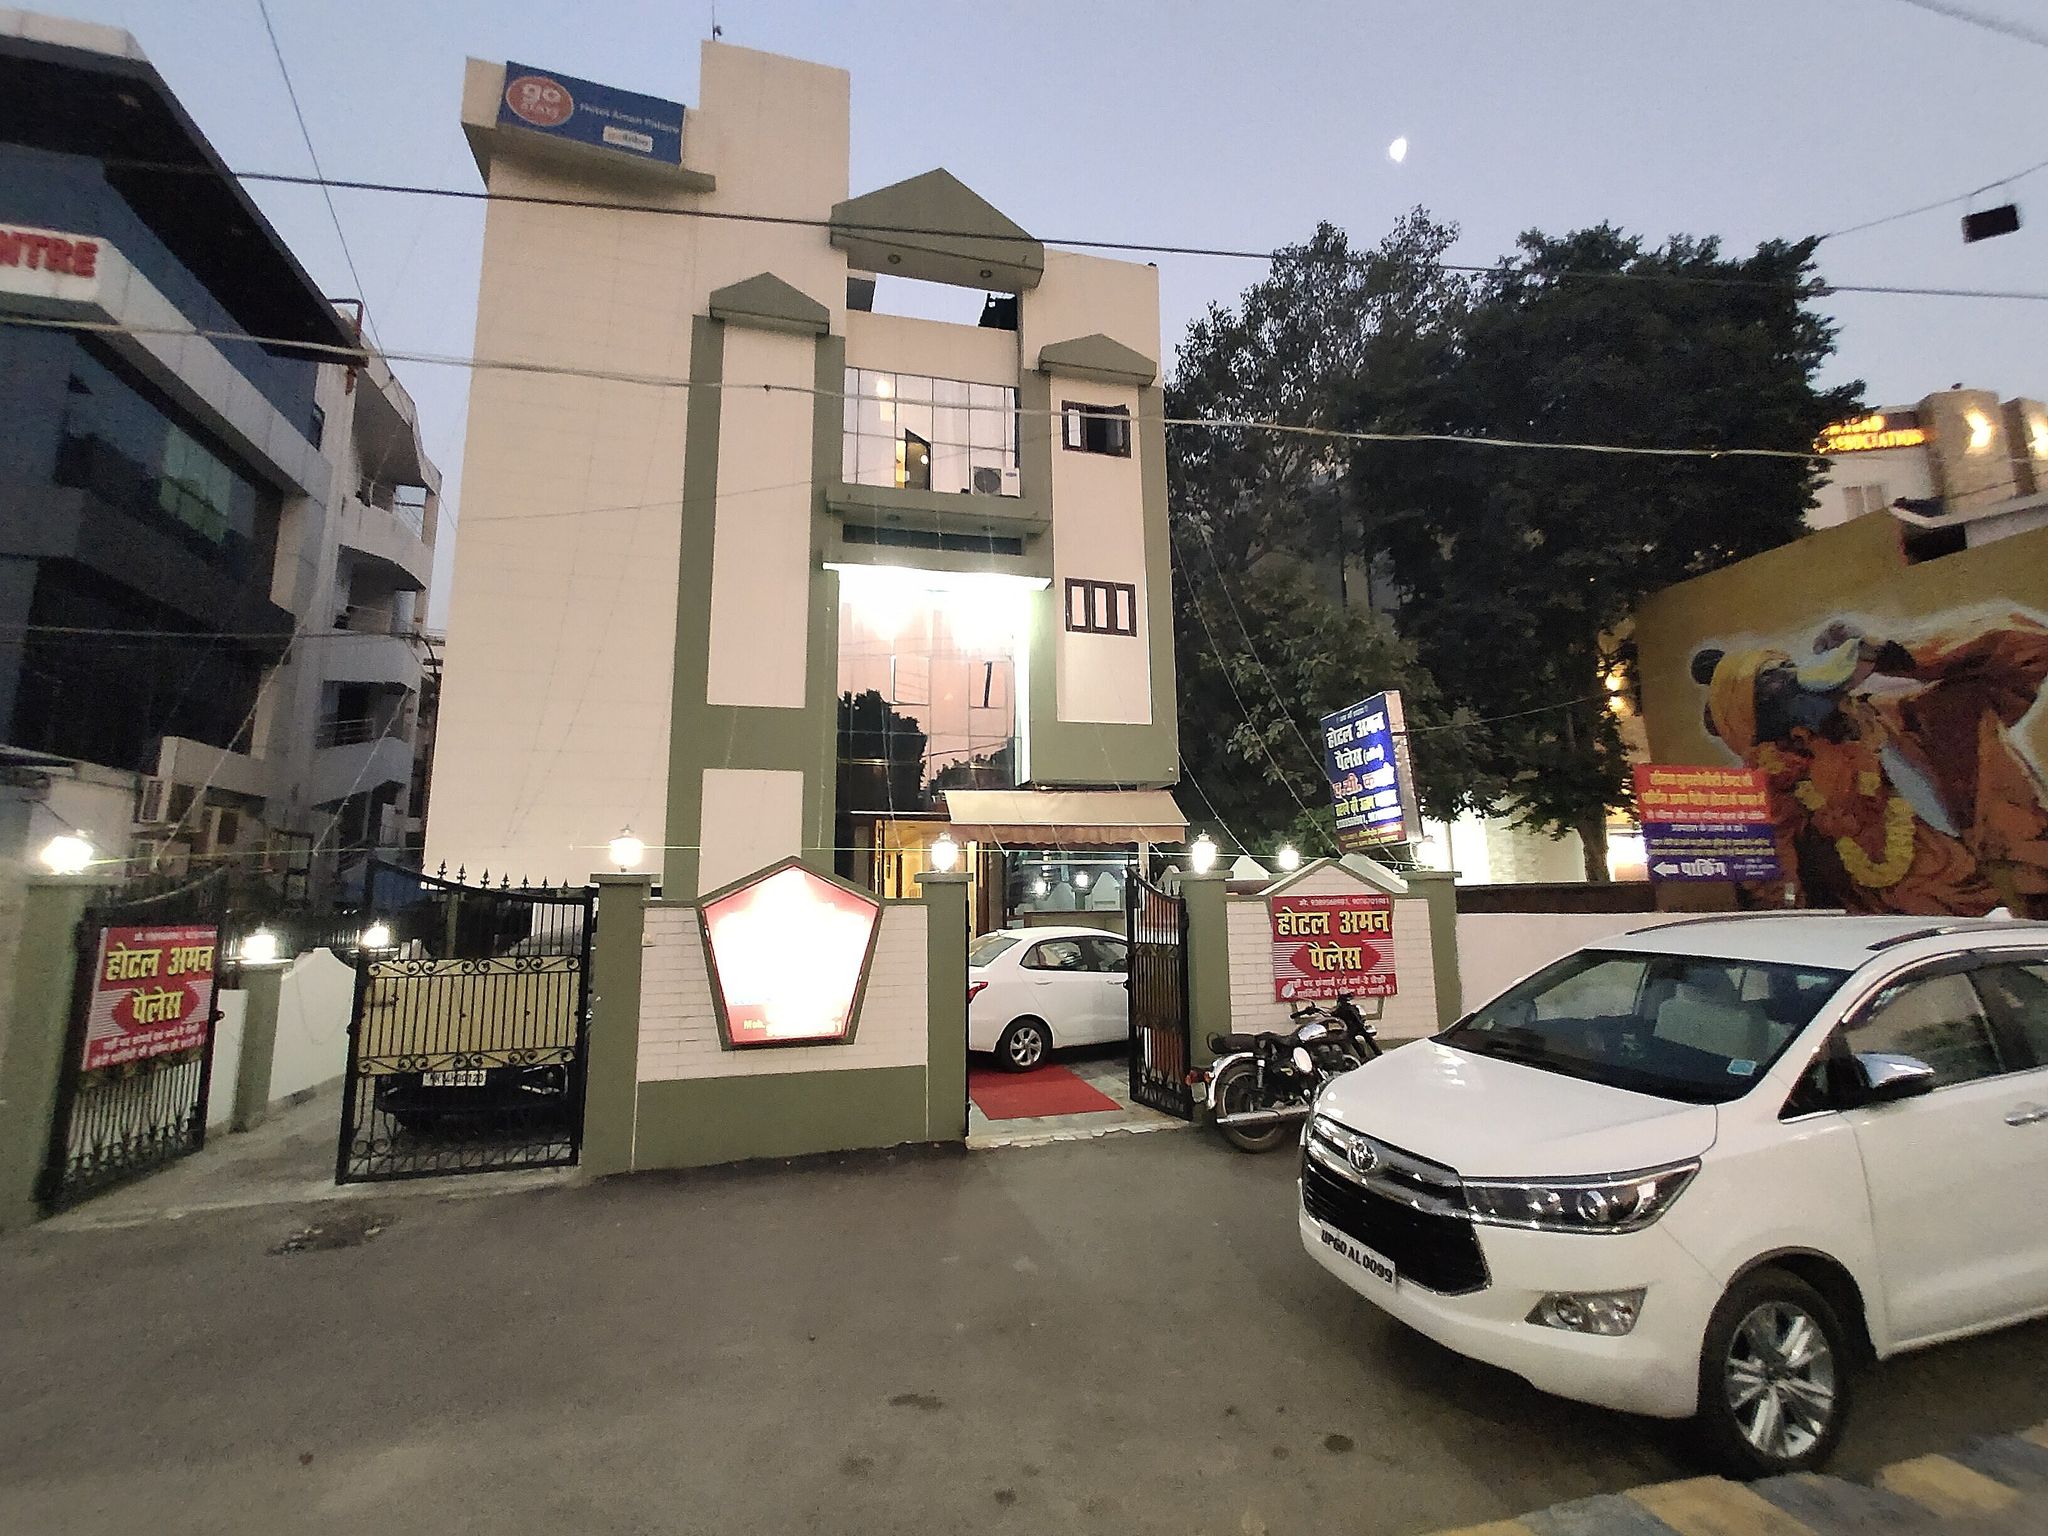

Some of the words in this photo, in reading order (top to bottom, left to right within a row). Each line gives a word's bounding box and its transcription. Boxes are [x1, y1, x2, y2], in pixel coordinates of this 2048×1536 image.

[1274, 906, 1331, 936] होटल
[1339, 910, 1390, 934] अमन
[106, 942, 163, 981] होटल
[167, 946, 215, 976] अमन
[1306, 941, 1362, 971] पैलेस
[132, 986, 184, 1024] पैलेस
[1348, 1246, 1362, 1266] AL
[1363, 1254, 1393, 1284] 0099
